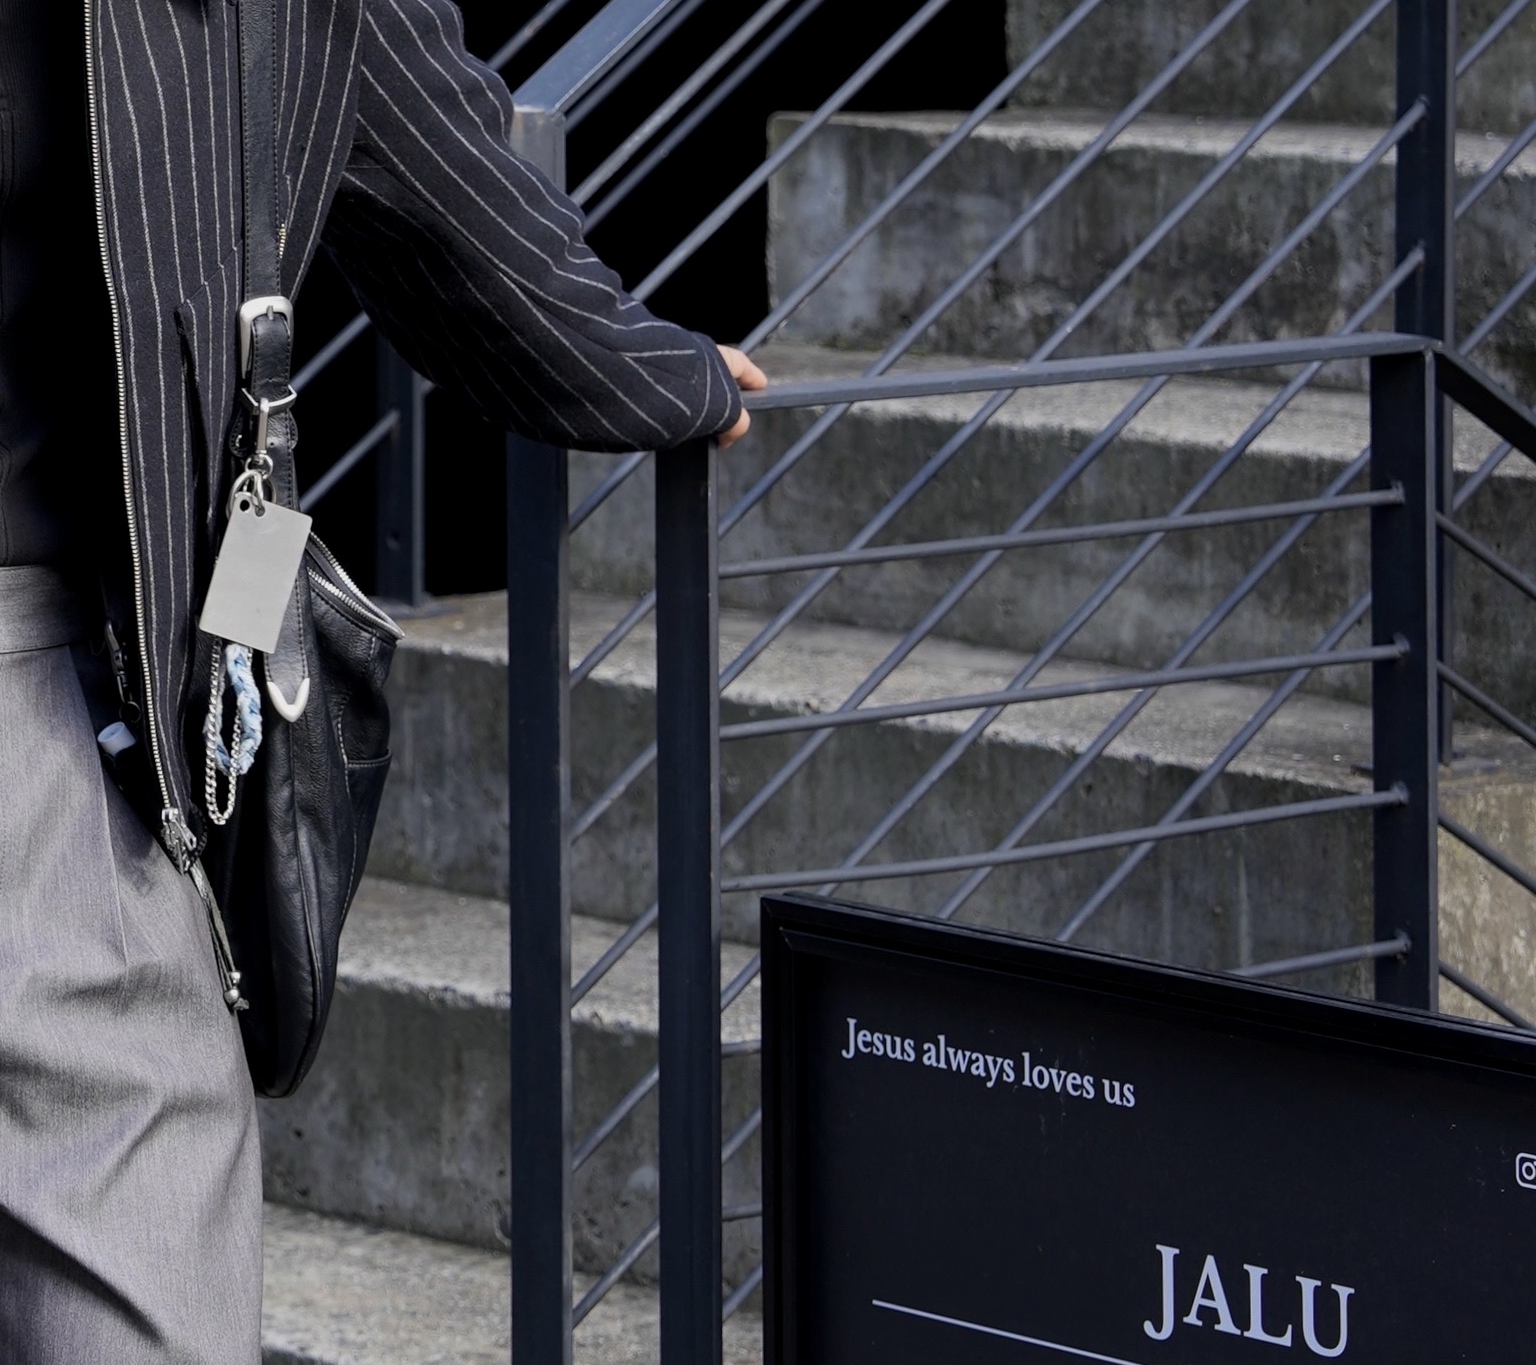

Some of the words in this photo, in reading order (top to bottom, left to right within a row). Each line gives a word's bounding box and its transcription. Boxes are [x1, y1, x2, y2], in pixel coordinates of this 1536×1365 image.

[841, 1017, 916, 1063] Jesus
[922, 1034, 1016, 1089] always
[1021, 1051, 1095, 1100] loves
[1101, 1078, 1136, 1108] us
[1143, 1243, 1355, 1358] JALU
